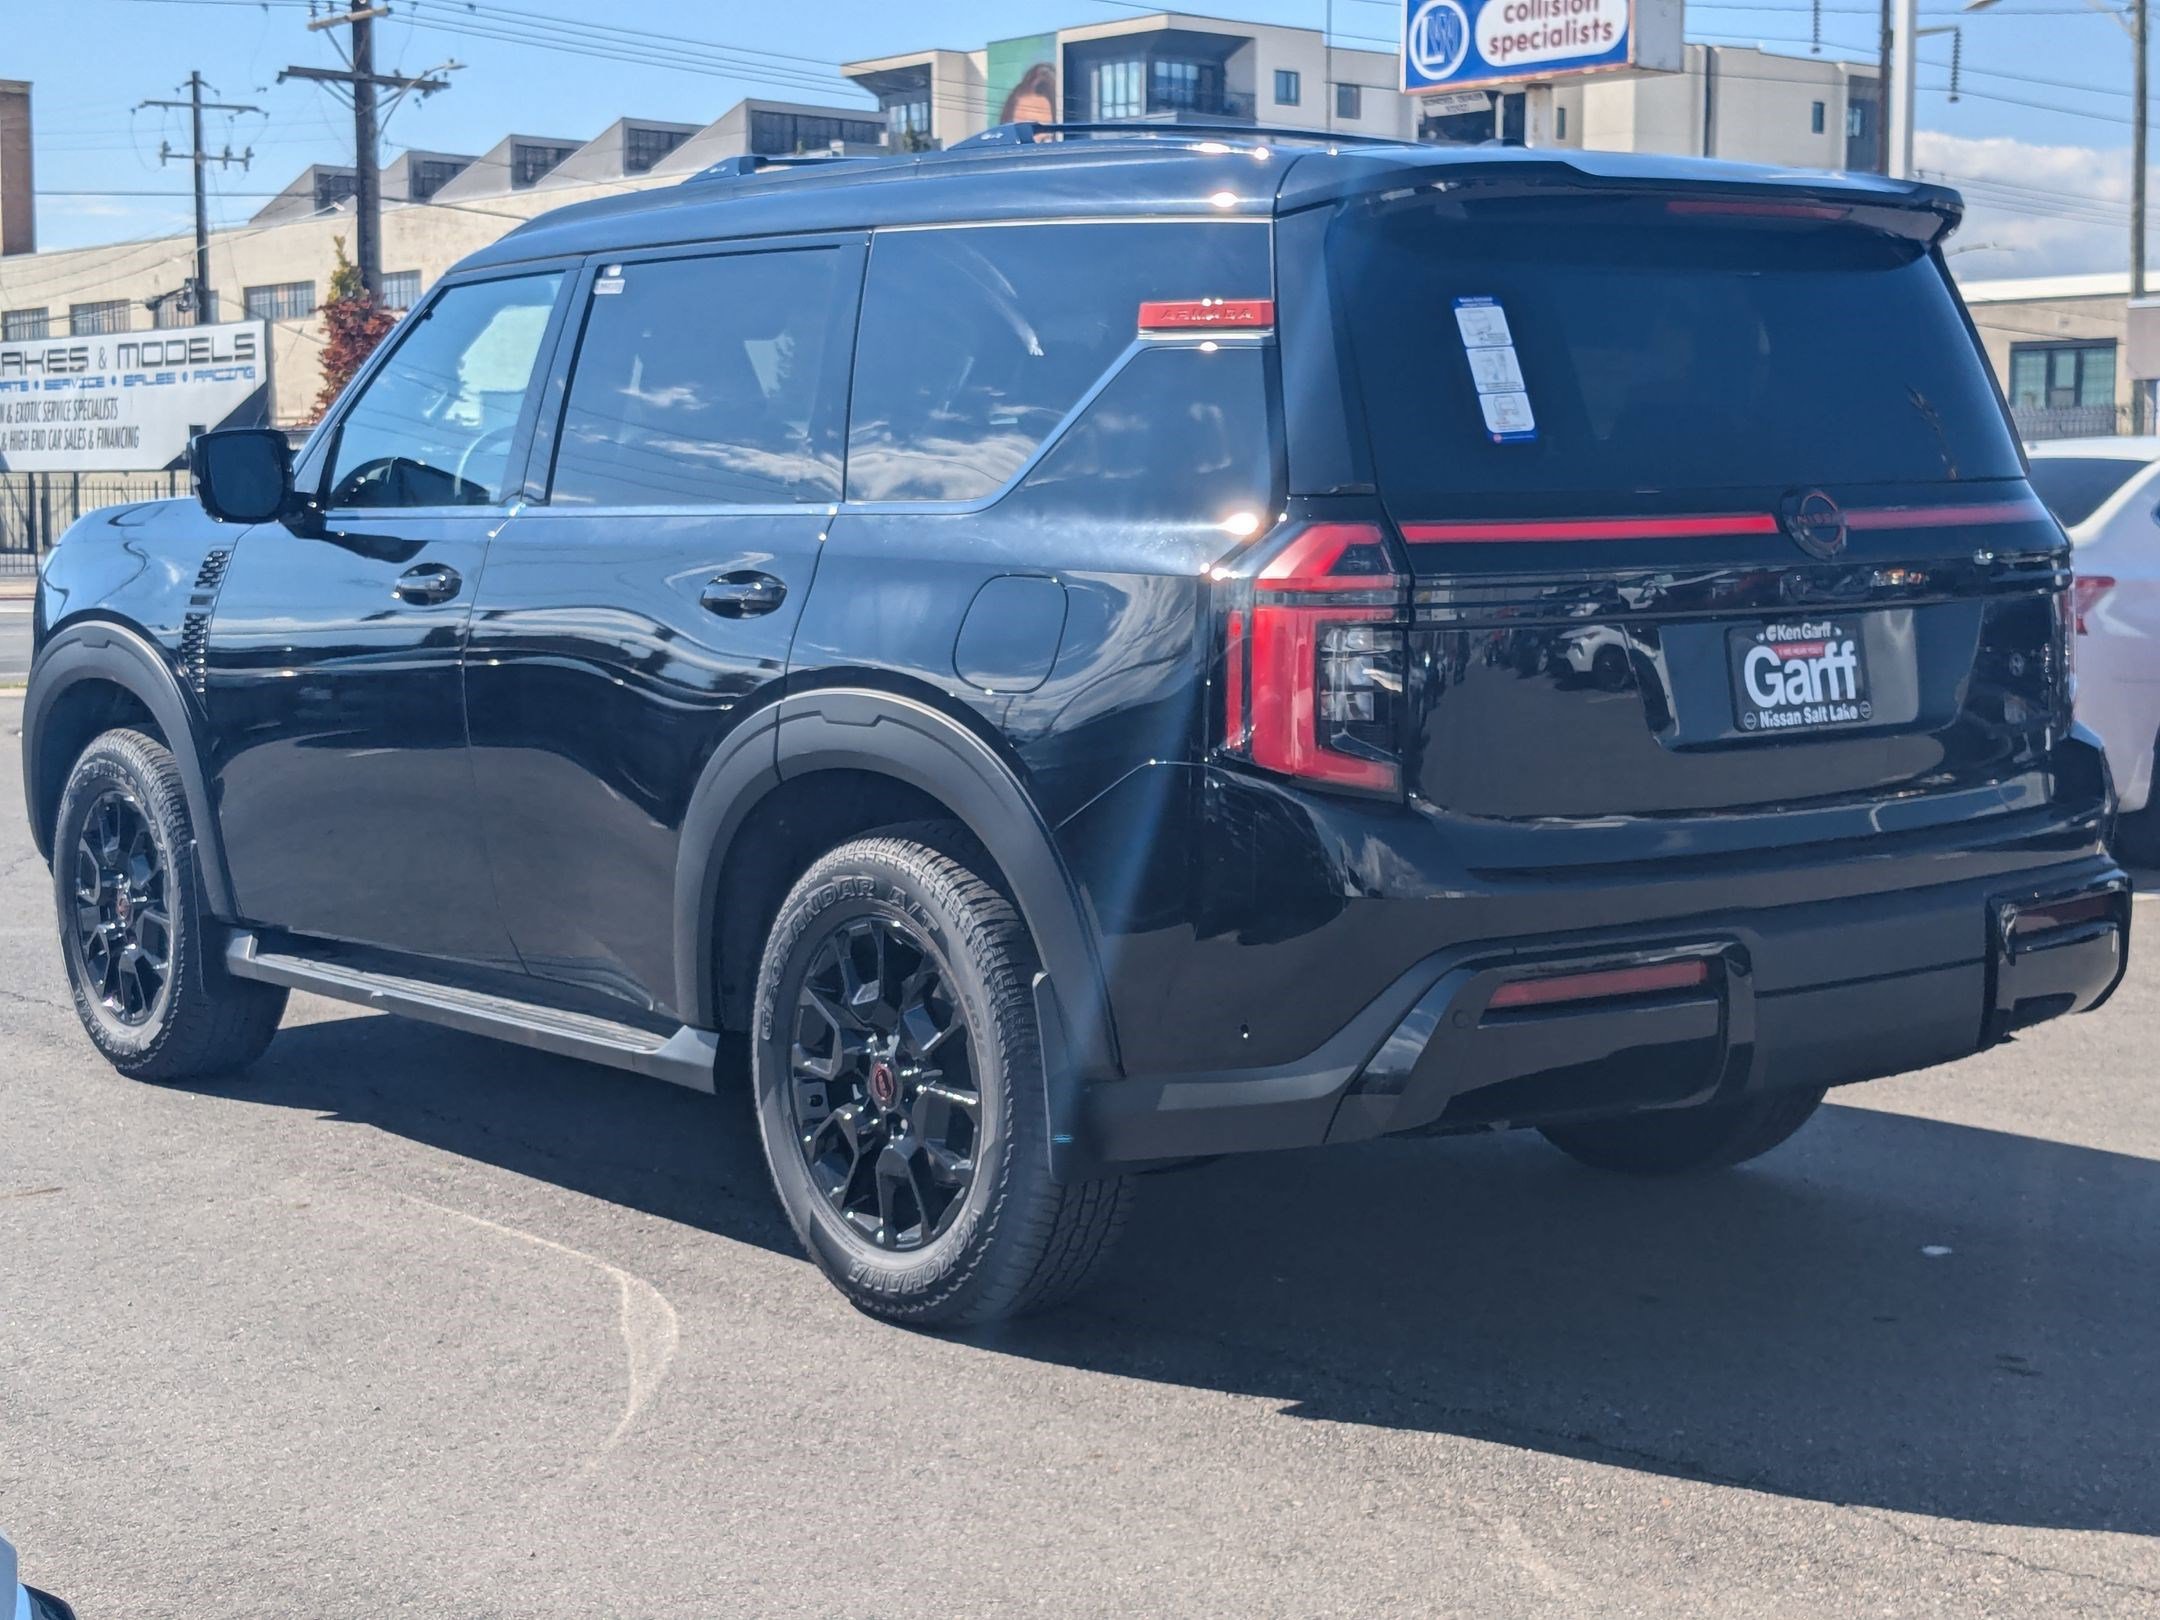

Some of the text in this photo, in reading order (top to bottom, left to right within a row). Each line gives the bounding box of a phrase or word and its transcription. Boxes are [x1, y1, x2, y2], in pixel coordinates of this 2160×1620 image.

[1504, 0, 1600, 23] collision
[1489, 20, 1613, 61] specialists
[0, 333, 256, 376] AKES & MODELS
[15, 401, 41, 423] EXOTIC
[42, 400, 71, 422] SERVICE
[73, 397, 119, 421] SPECIALISTS
[48, 428, 62, 451] CAR
[64, 427, 87, 450] SALES
[96, 425, 140, 449] FINANCING
[1744, 640, 1858, 708] Garff
[1759, 702, 1858, 729] Nissan Salt Lake
